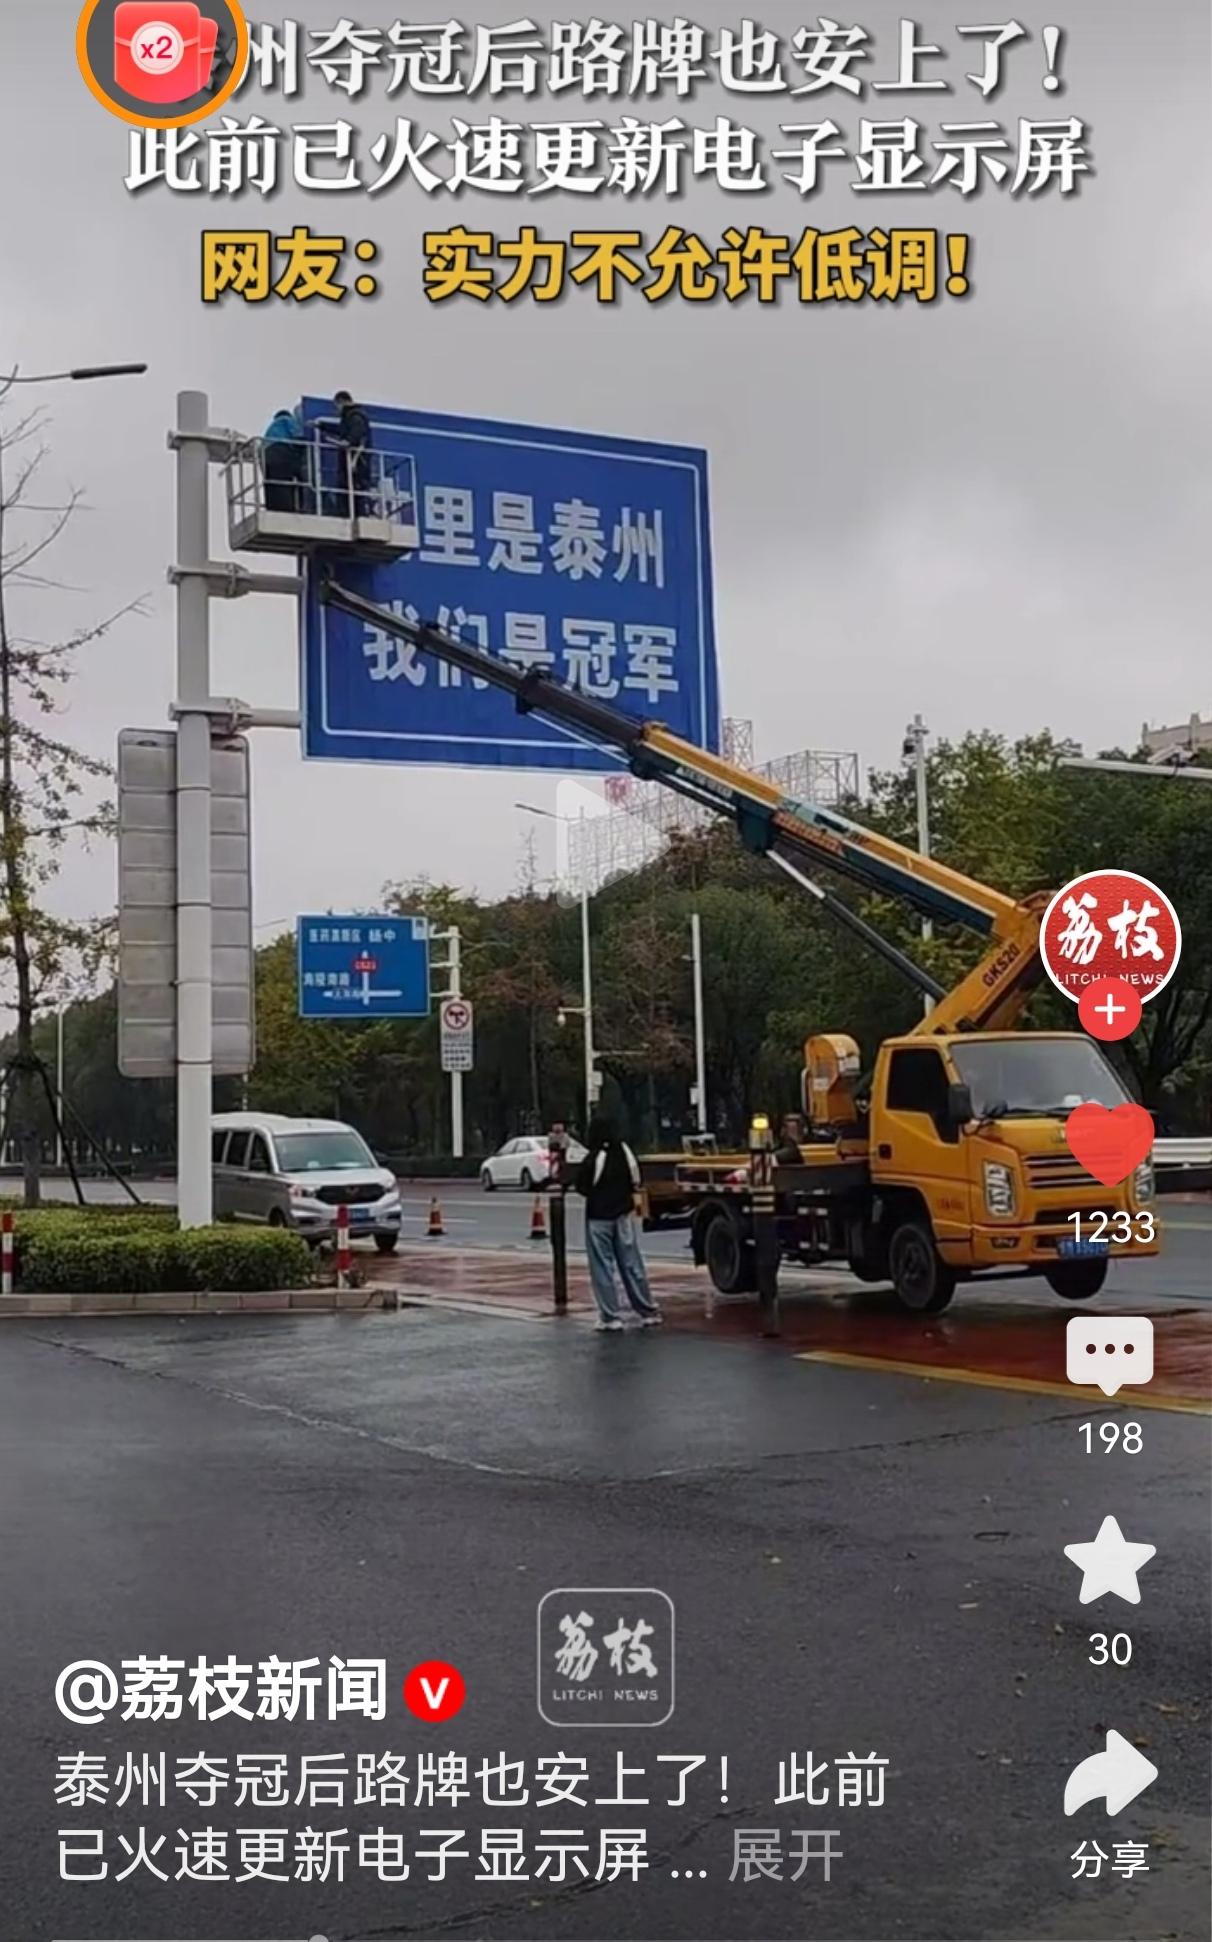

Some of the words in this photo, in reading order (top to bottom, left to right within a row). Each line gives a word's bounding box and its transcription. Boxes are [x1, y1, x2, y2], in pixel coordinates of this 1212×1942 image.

[362, 600, 680, 703] 我们是冠军
